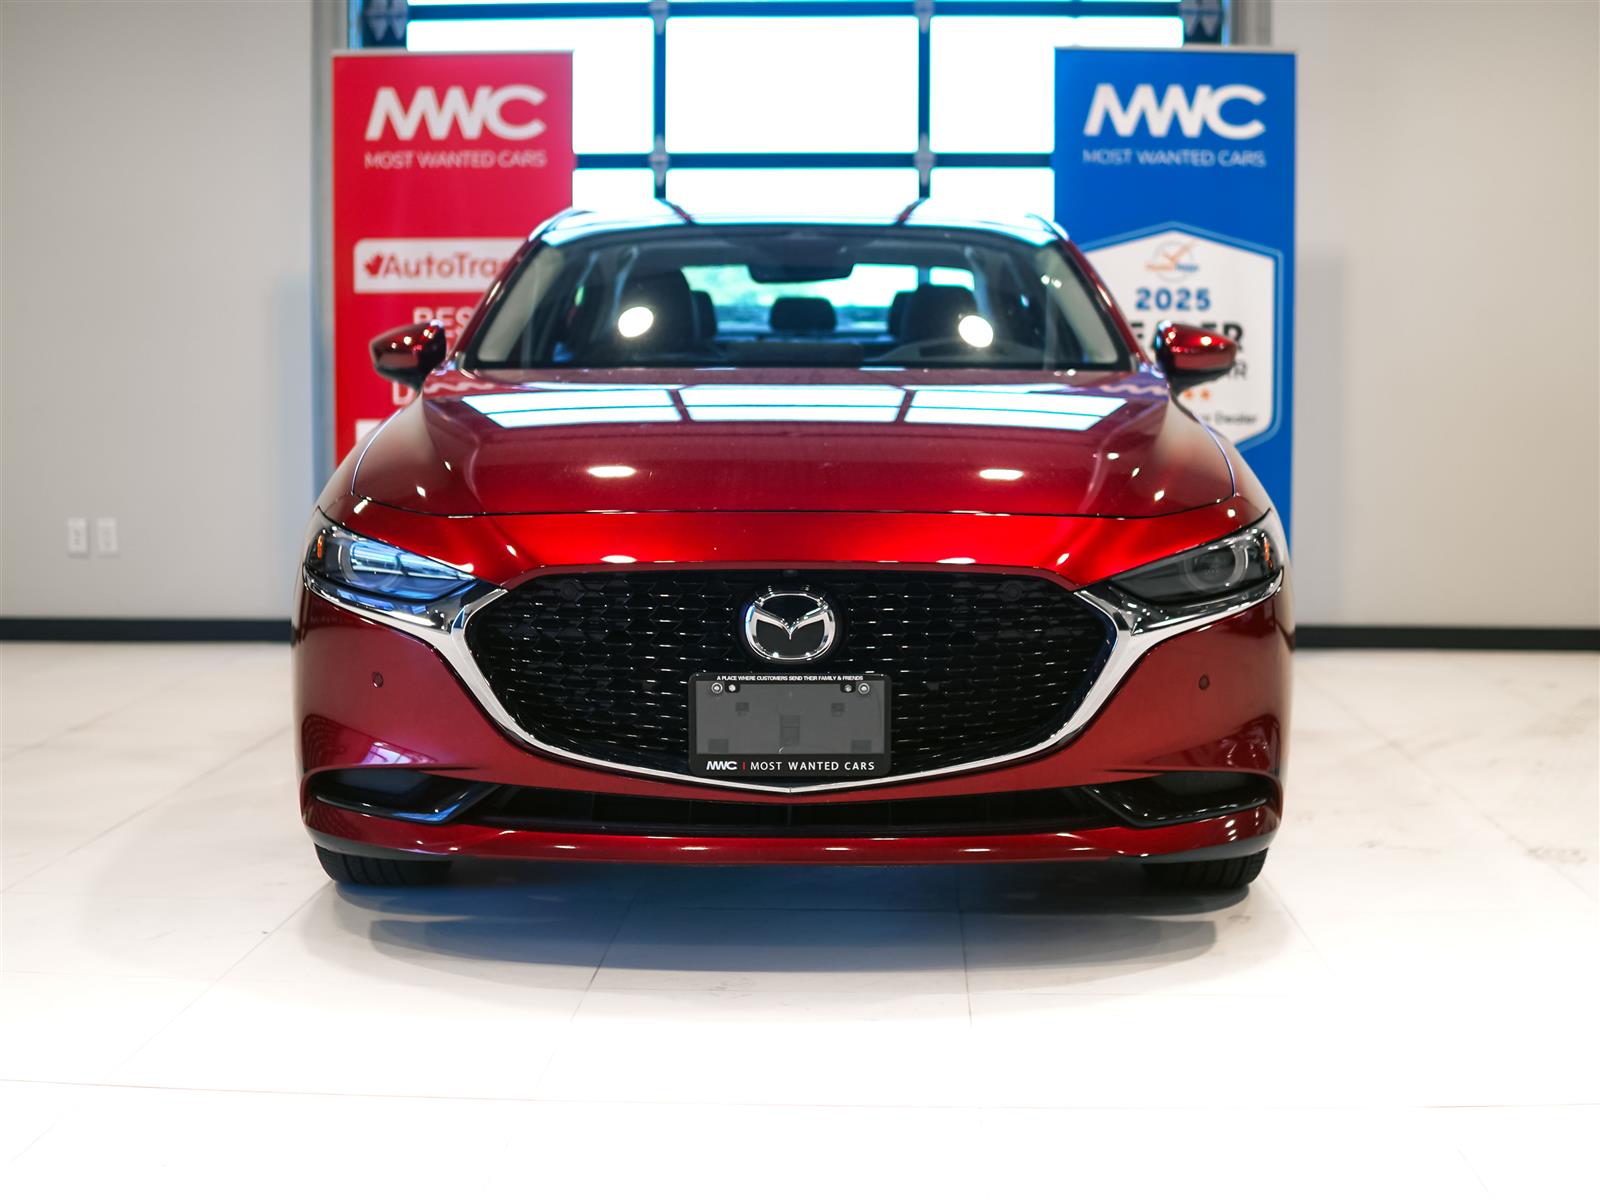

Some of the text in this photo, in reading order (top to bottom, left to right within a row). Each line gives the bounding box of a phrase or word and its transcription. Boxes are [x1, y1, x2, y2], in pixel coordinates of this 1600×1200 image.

[364, 84, 547, 141] MWC
[1083, 83, 1266, 140] MWC
[364, 150, 547, 169] MOST WANTED CARS
[1082, 149, 1266, 168] MOST WANTED CARS
[383, 253, 510, 278] AutoTra
[1136, 287, 1211, 312] 2025
[706, 760, 875, 771] MWC MOST WANTED CARS
